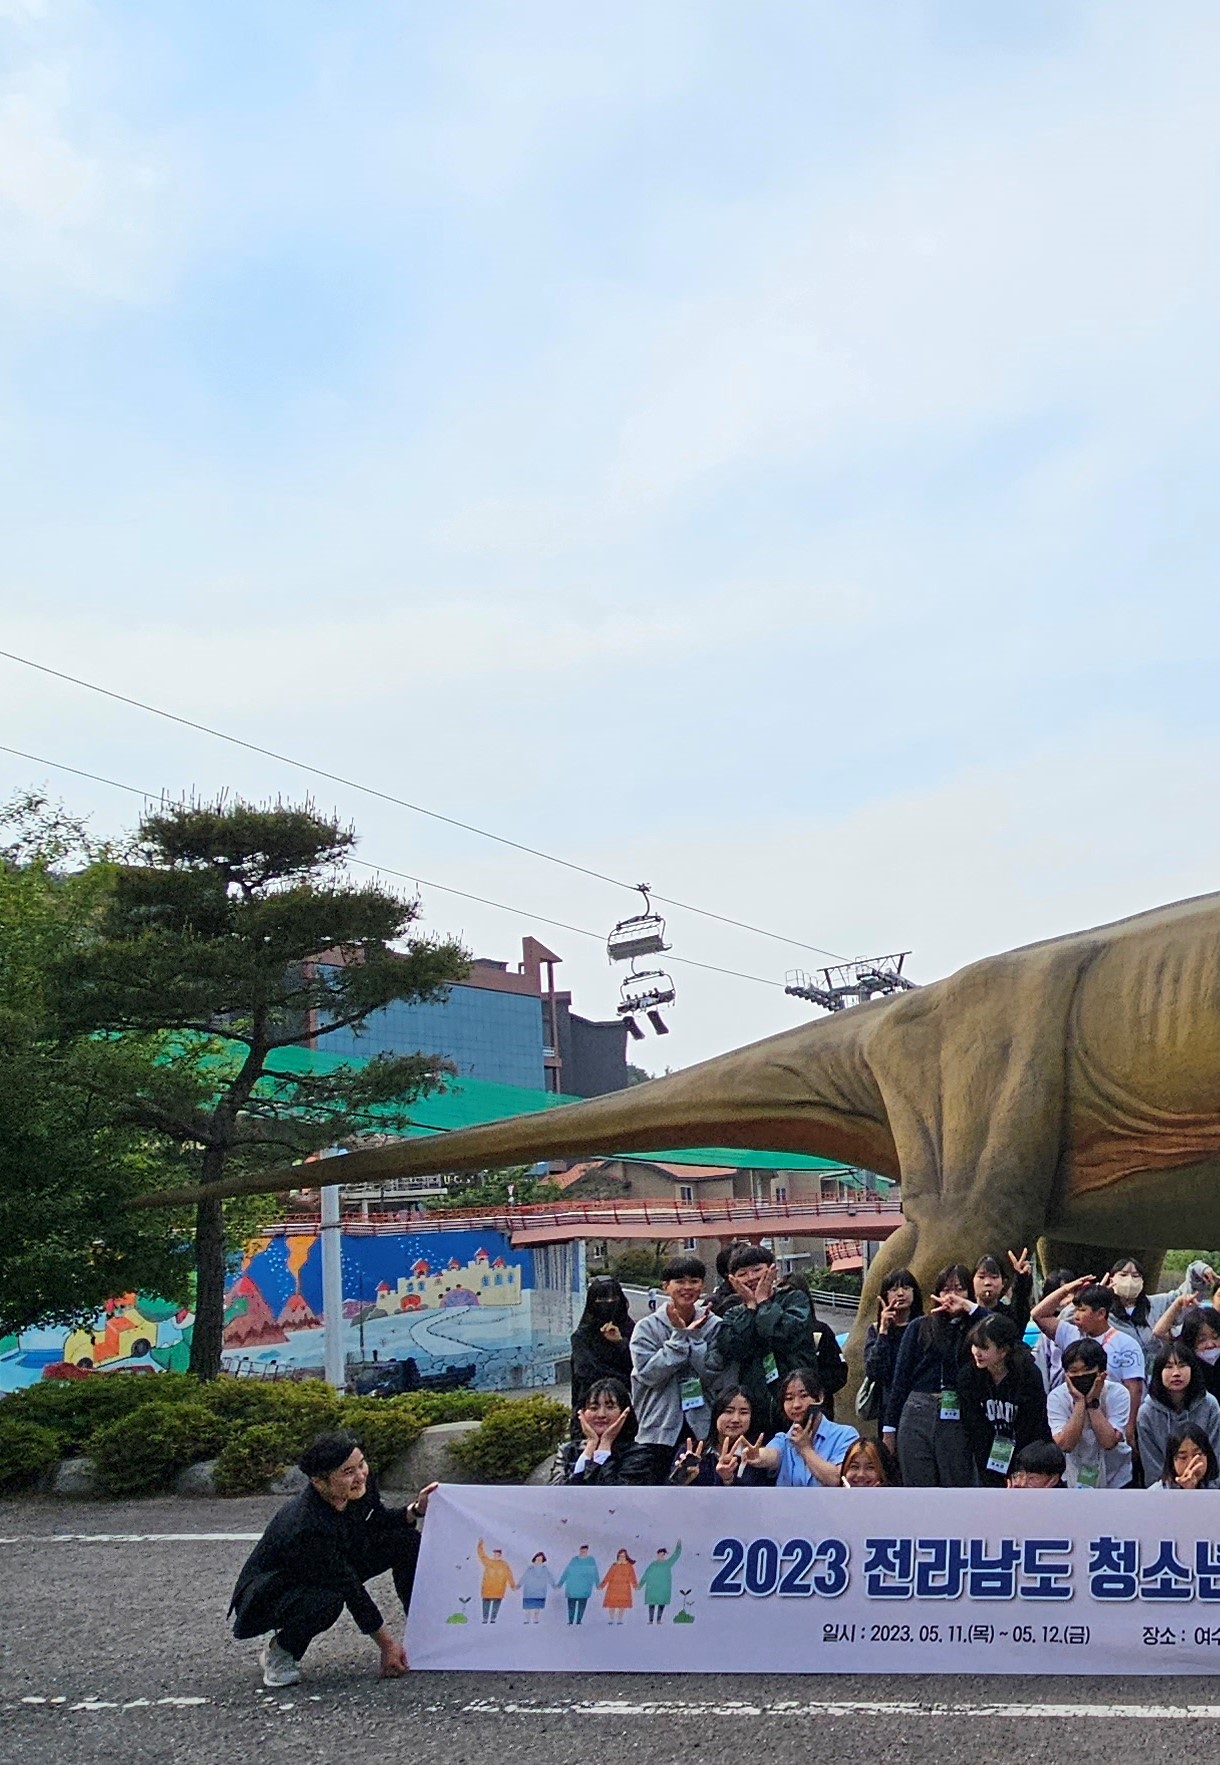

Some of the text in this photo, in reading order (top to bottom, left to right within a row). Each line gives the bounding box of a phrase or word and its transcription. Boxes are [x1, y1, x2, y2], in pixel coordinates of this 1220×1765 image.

[710, 1536, 850, 1599] 2023
[863, 1536, 1074, 1602] 전라남도
[822, 1623, 856, 1643] 일시
[870, 1625, 914, 1643] 2023.
[919, 1625, 943, 1643] 05.
[1012, 1625, 1036, 1643] 05.
[1142, 1626, 1177, 1646] 장소
